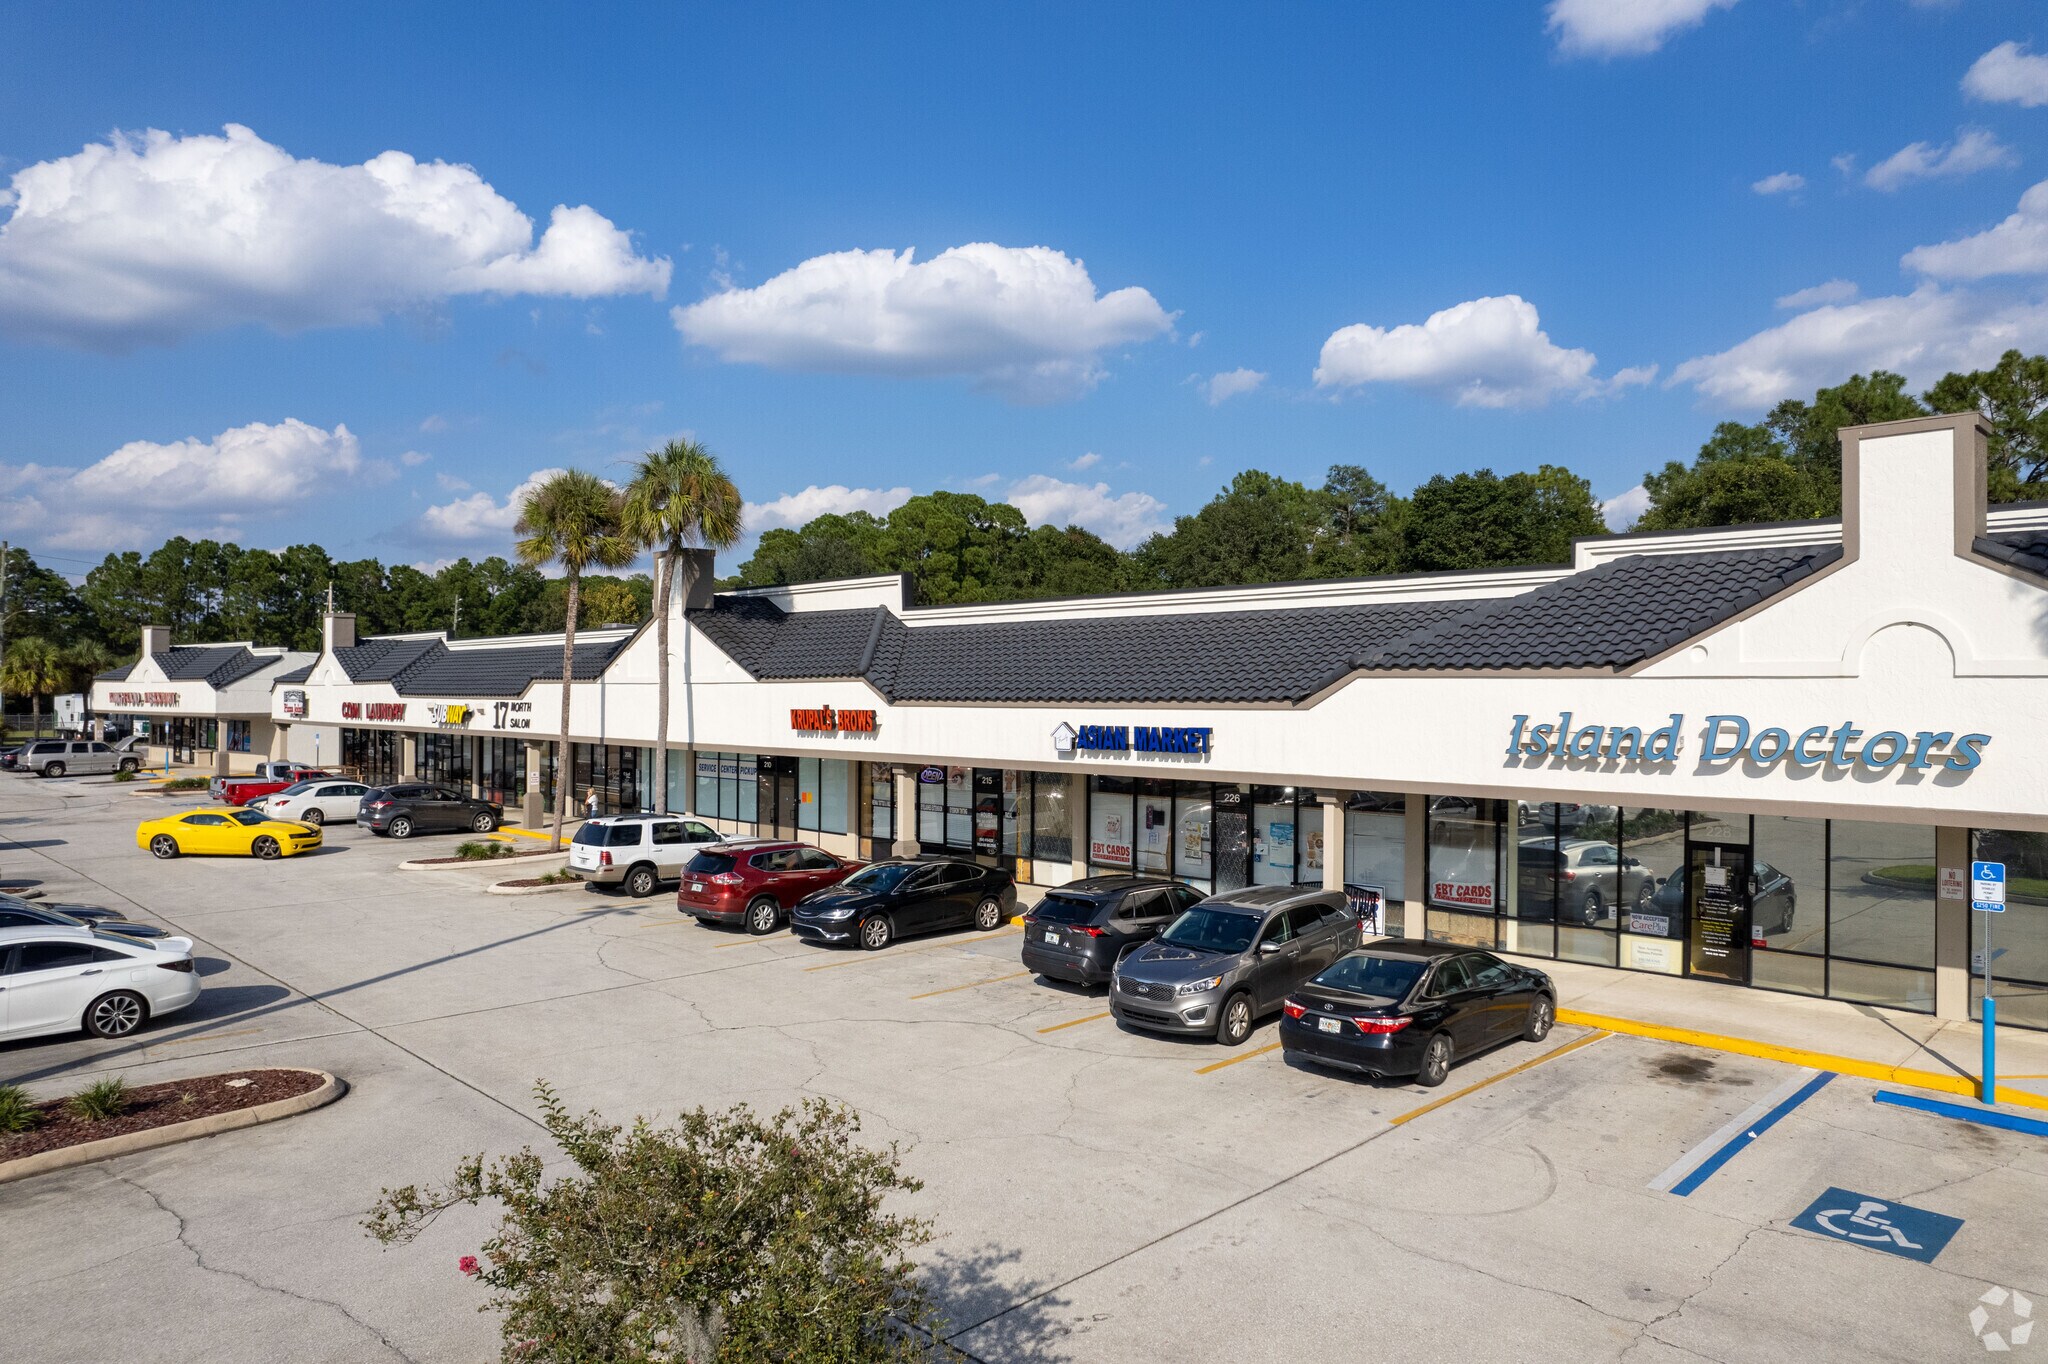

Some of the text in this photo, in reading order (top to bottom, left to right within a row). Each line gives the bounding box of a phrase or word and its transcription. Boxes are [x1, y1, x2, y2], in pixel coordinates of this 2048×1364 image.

[342, 702, 406, 720] COIN LAUNDRY
[510, 702, 532, 712] NORTH
[432, 704, 468, 725] SUBWAY
[493, 702, 509, 729] 17
[790, 704, 876, 732] KRUPAL'S BROWS
[510, 718, 530, 729] SALON
[1077, 724, 1128, 750] ASIAN
[1134, 726, 1212, 754] MARKET
[1505, 712, 1992, 772] Island Doctors
[698, 763, 757, 775] SERVICE CENTER PICKUP
[923, 770, 941, 781] OPEN
[982, 776, 993, 785] 215
[1224, 793, 1240, 802] 226
[1092, 842, 1130, 857] EBT CARDS
[1436, 883, 1491, 898] EBT CARDS
[1942, 880, 1962, 888] LOITERING
[1631, 920, 1667, 932] CarePlus
